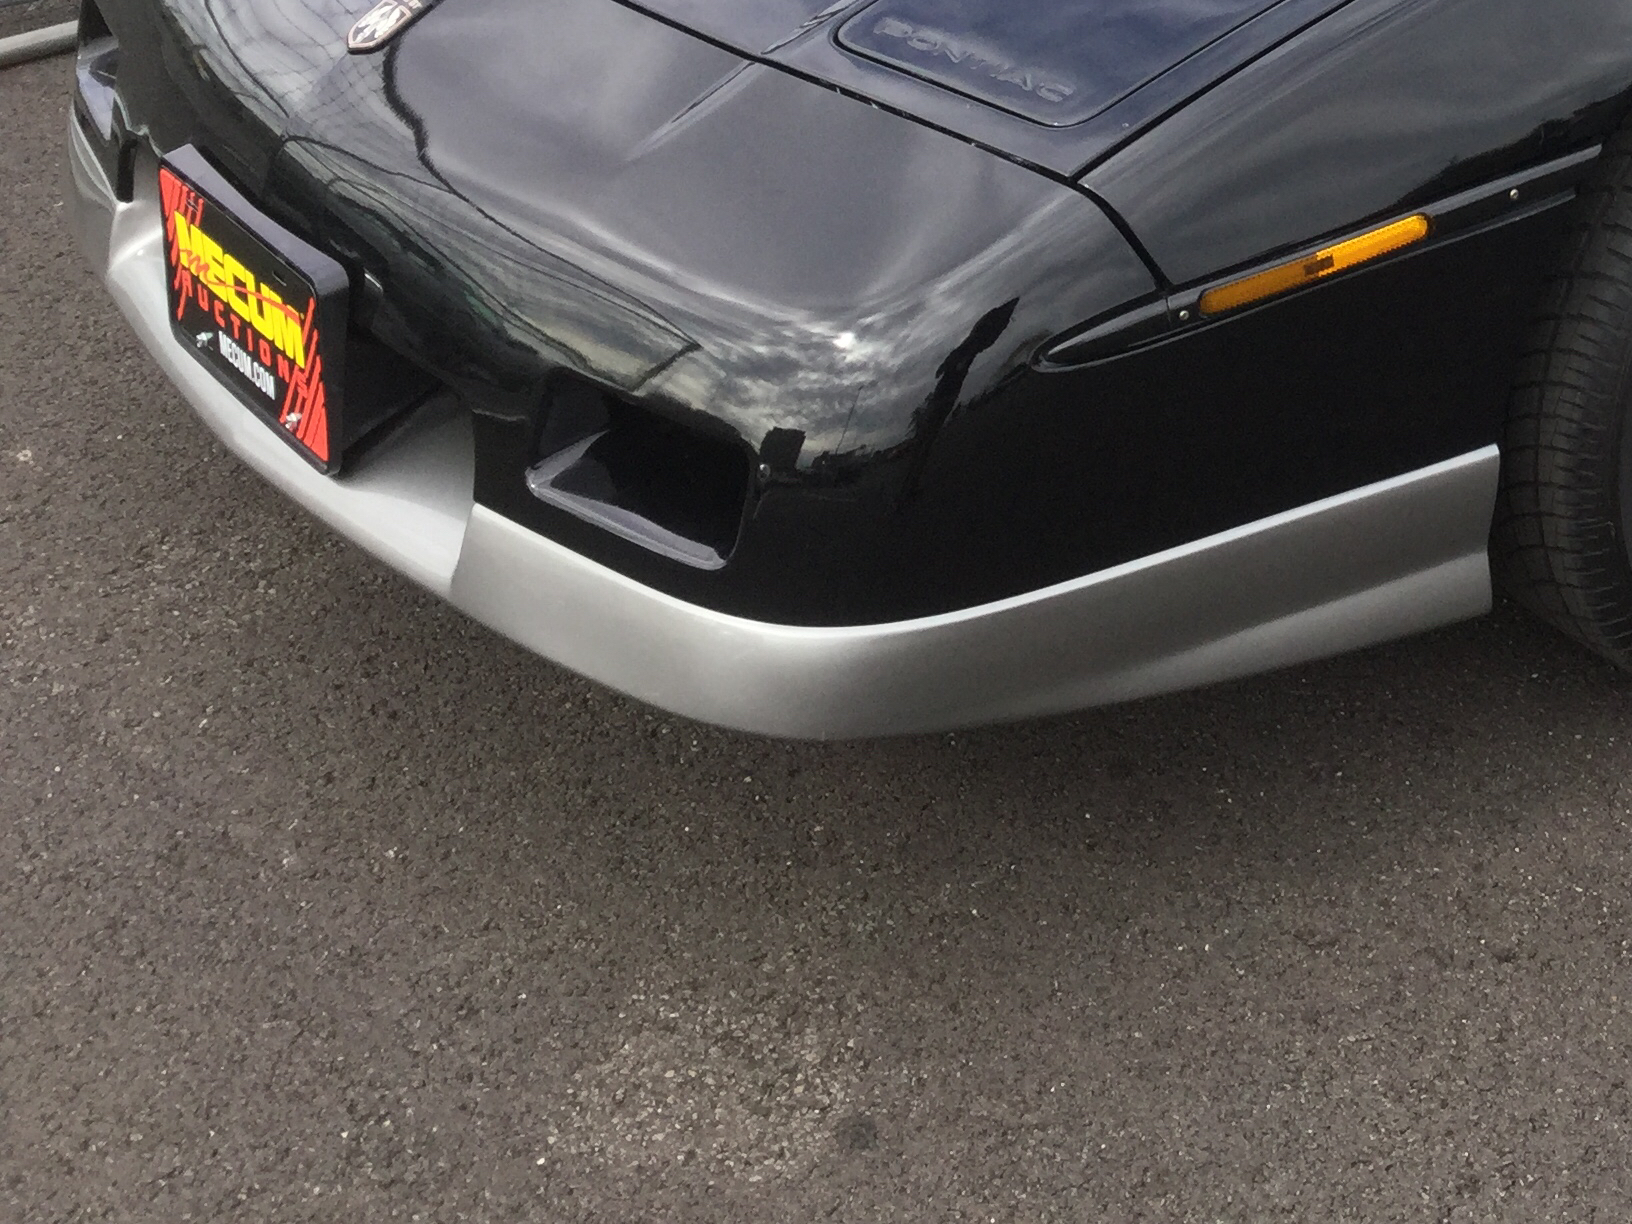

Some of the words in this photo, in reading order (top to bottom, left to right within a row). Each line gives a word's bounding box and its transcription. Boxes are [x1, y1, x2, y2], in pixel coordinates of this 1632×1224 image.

[174, 210, 305, 369] MECUM
[180, 269, 309, 400] AUCTIONS
[218, 329, 276, 401] MECUM.COM
